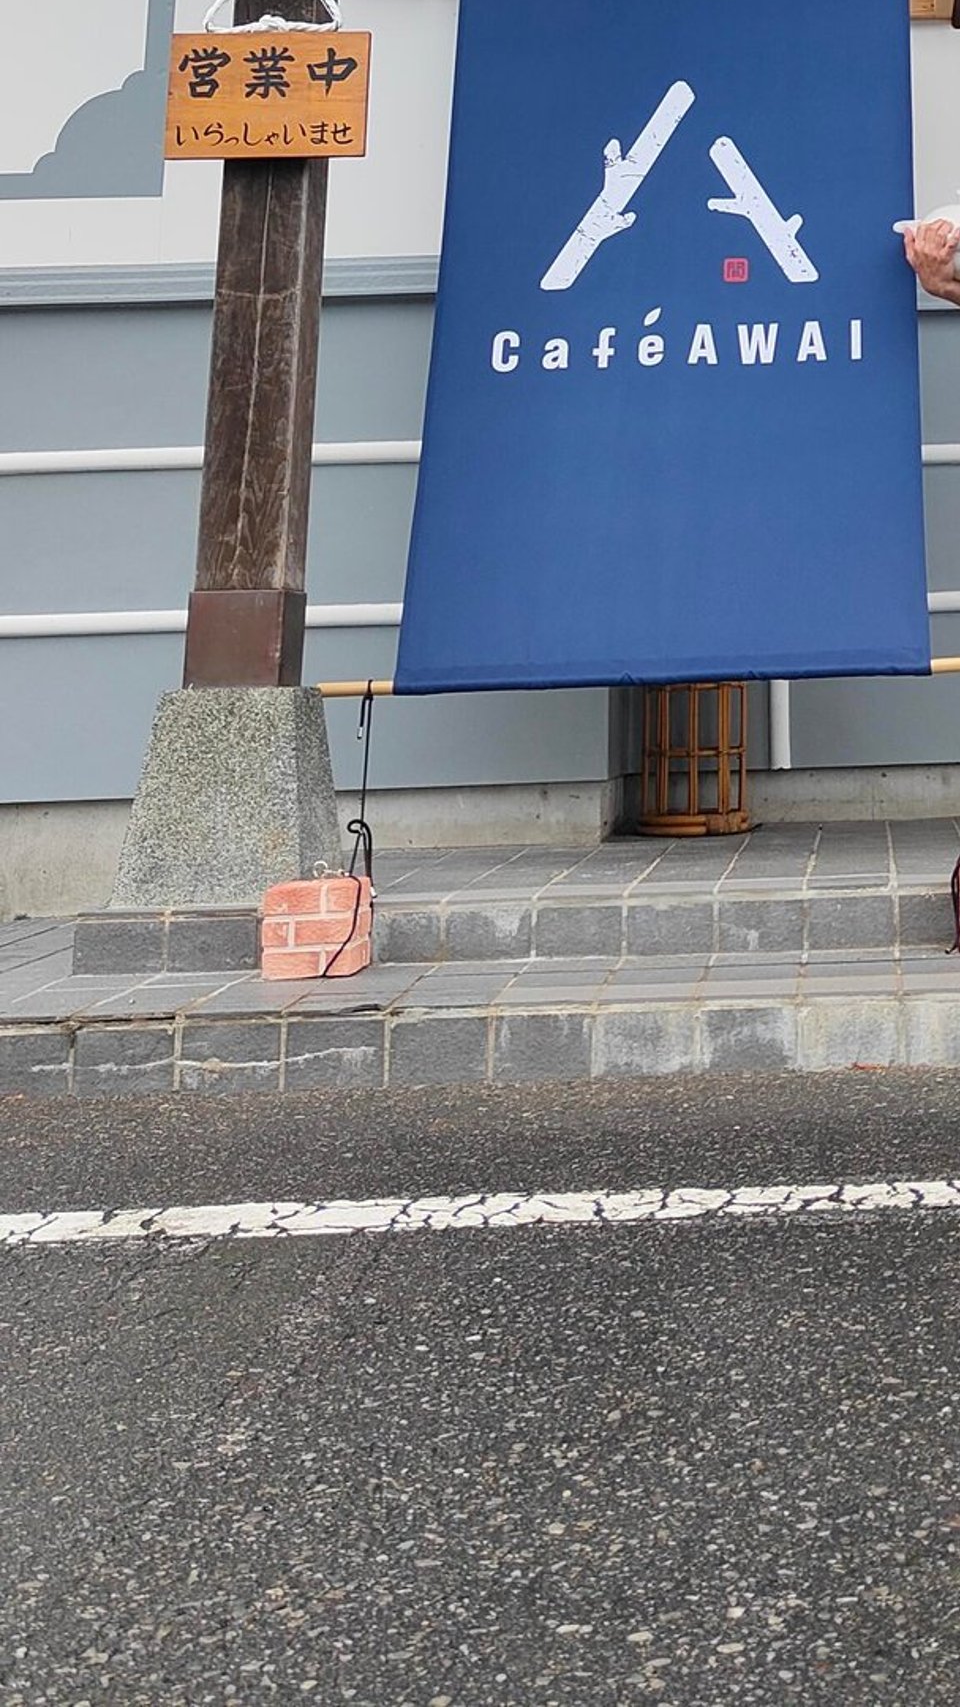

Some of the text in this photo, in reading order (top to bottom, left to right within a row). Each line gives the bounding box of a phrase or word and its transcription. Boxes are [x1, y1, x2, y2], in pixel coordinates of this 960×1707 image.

[178, 46, 358, 99] 営業中
[176, 121, 354, 147] いらっしゃいませ
